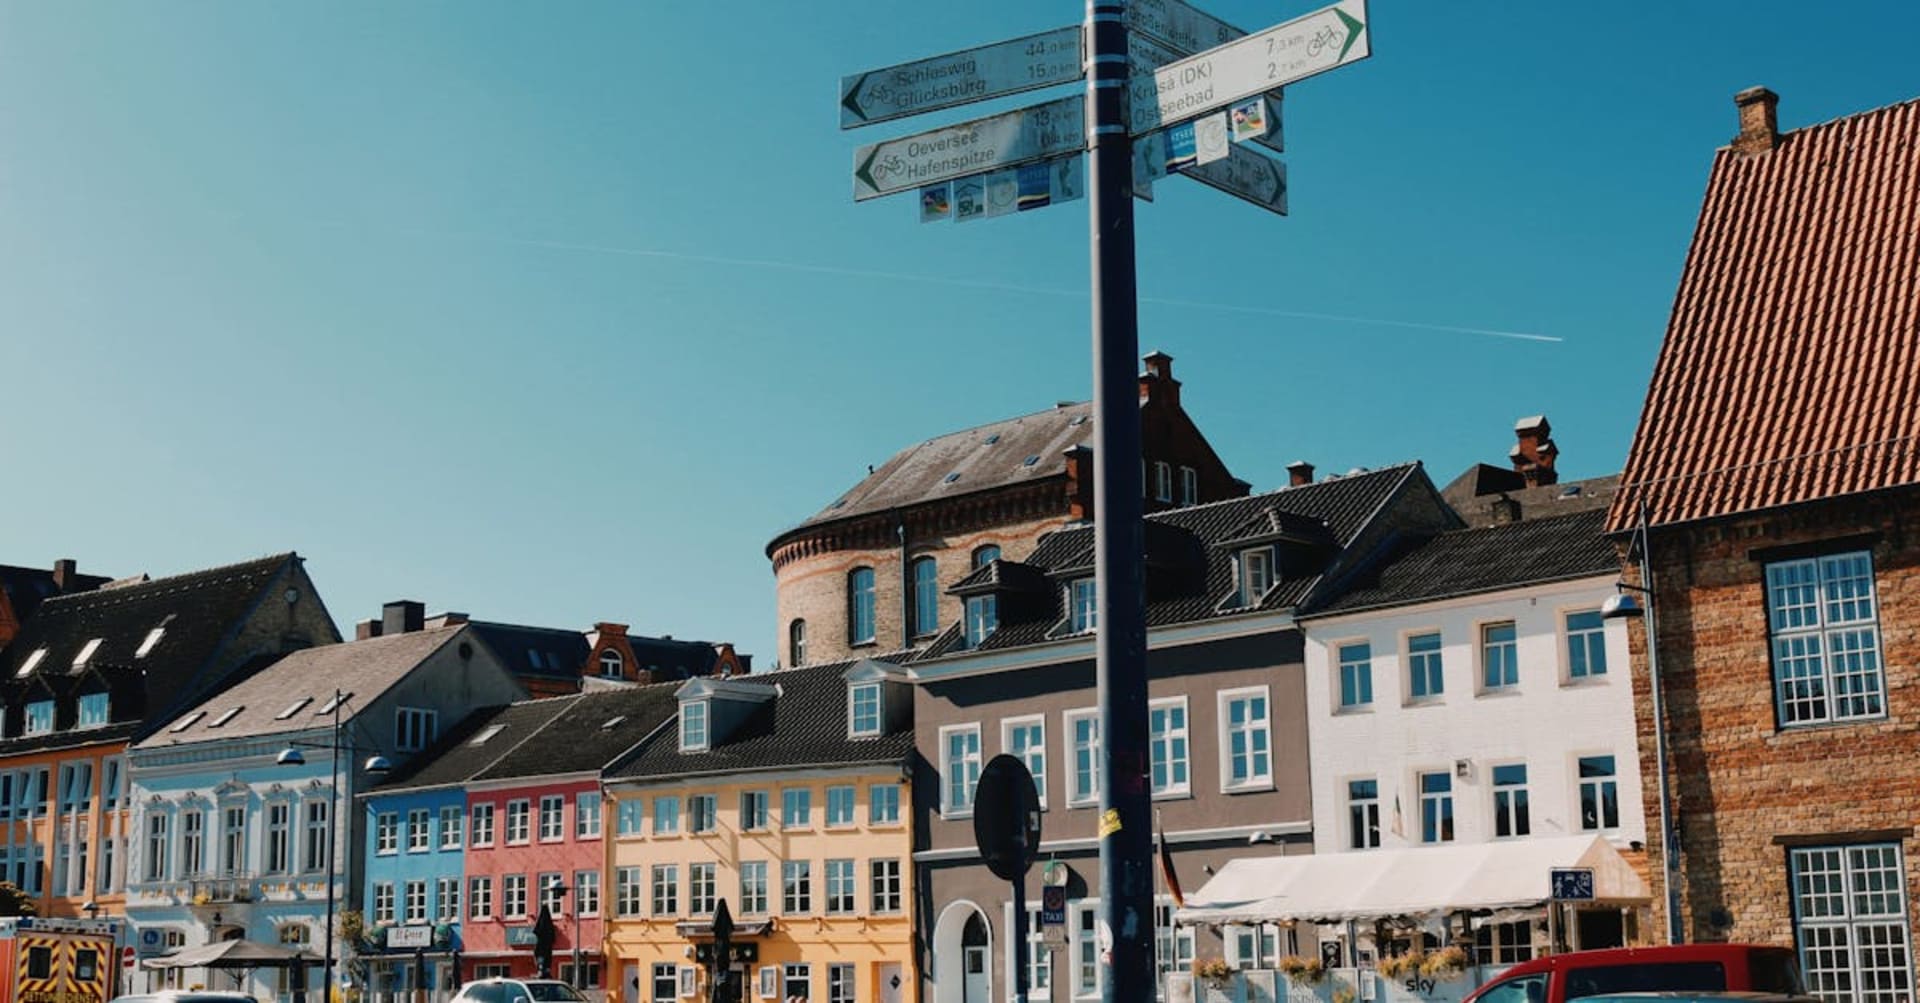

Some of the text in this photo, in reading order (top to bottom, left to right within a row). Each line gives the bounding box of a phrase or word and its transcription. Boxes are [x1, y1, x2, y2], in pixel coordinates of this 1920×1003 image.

[896, 60, 976, 87] Schleswig
[1180, 61, 1213, 87] (DK)
[896, 79, 986, 108] Glücksburg
[1135, 83, 1214, 125] Ostseebad
[908, 131, 979, 158] Oeversee
[908, 148, 995, 179] Hafenspitze
[1044, 911, 1064, 922] TAXI
[1406, 974, 1436, 997] sky
